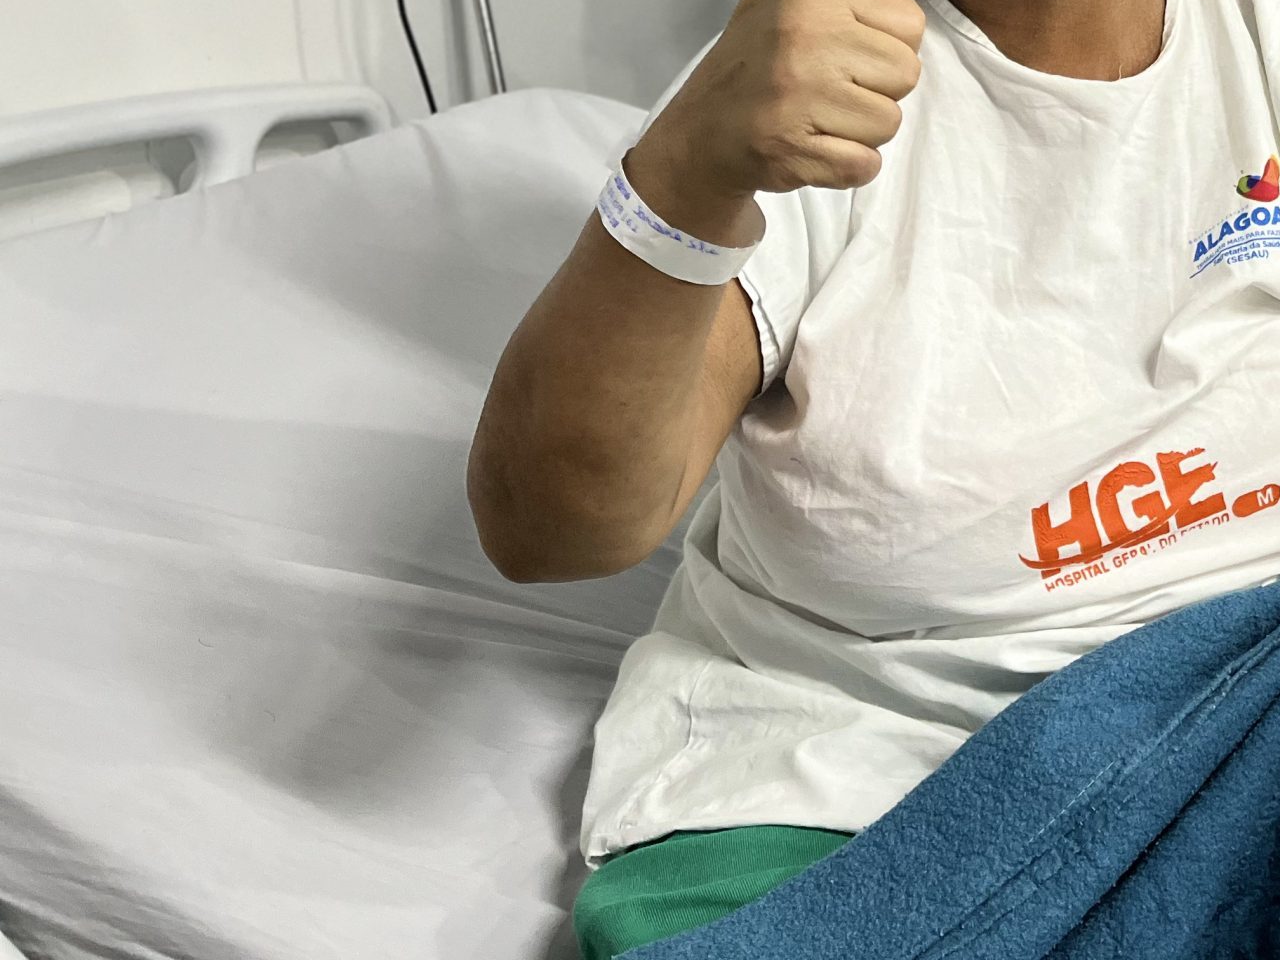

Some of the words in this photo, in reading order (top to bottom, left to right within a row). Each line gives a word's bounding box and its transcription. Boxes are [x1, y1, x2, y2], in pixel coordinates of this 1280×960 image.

[1250, 242, 1261, 250] da
[1227, 249, 1269, 265] (SESAU)
[1256, 487, 1275, 507] M
[1031, 447, 1226, 580] HGE
